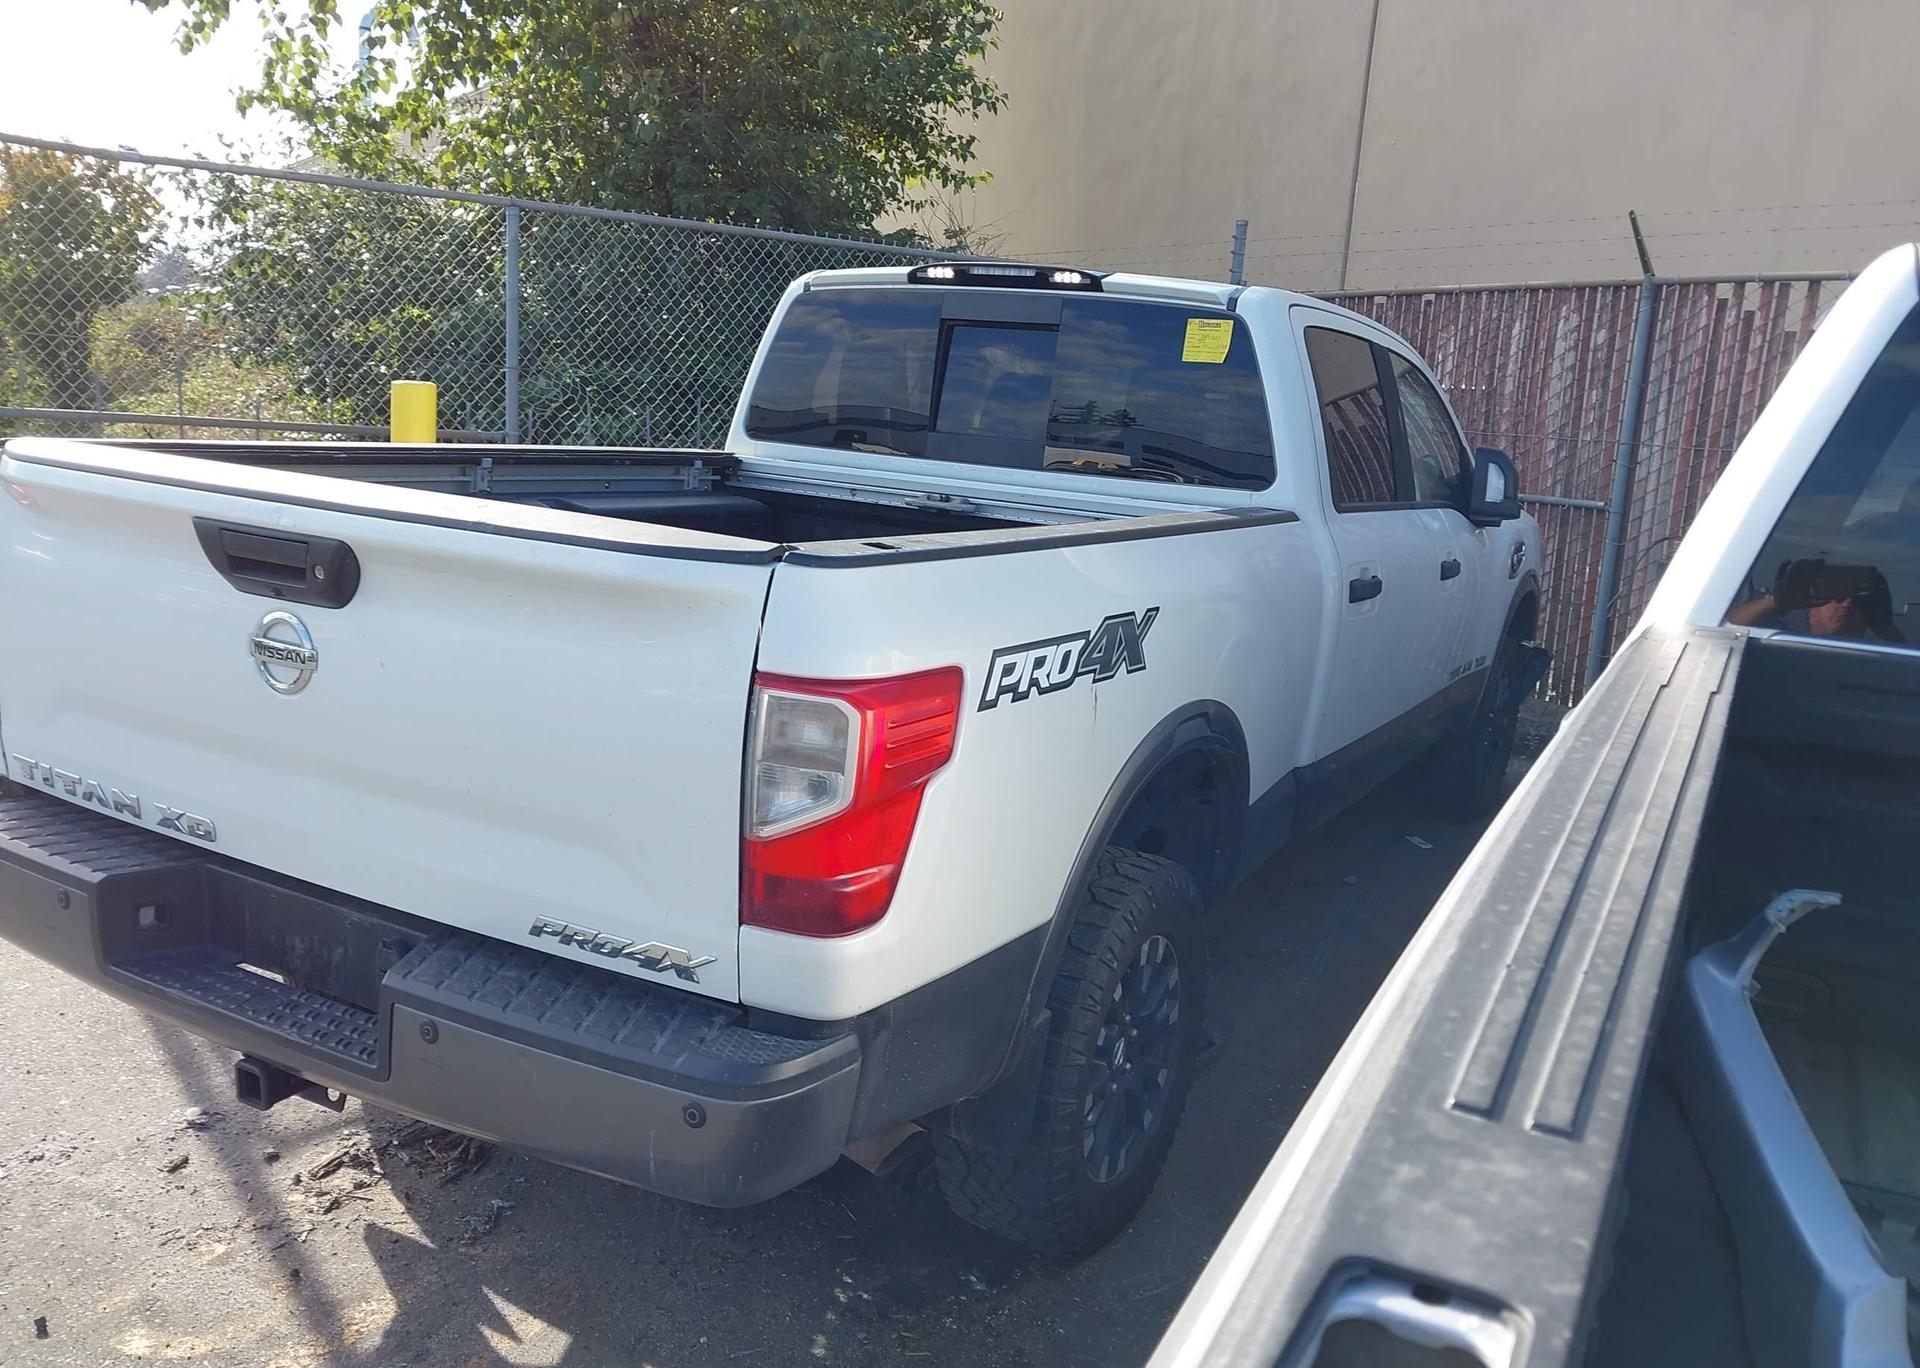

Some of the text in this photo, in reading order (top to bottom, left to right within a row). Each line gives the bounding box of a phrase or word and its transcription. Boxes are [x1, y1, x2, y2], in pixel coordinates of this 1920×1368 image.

[254, 641, 306, 665] NISSAN
[977, 606, 1160, 713] PRO4X
[12, 753, 217, 842] TITAN XD
[528, 913, 718, 984] PRO4X
